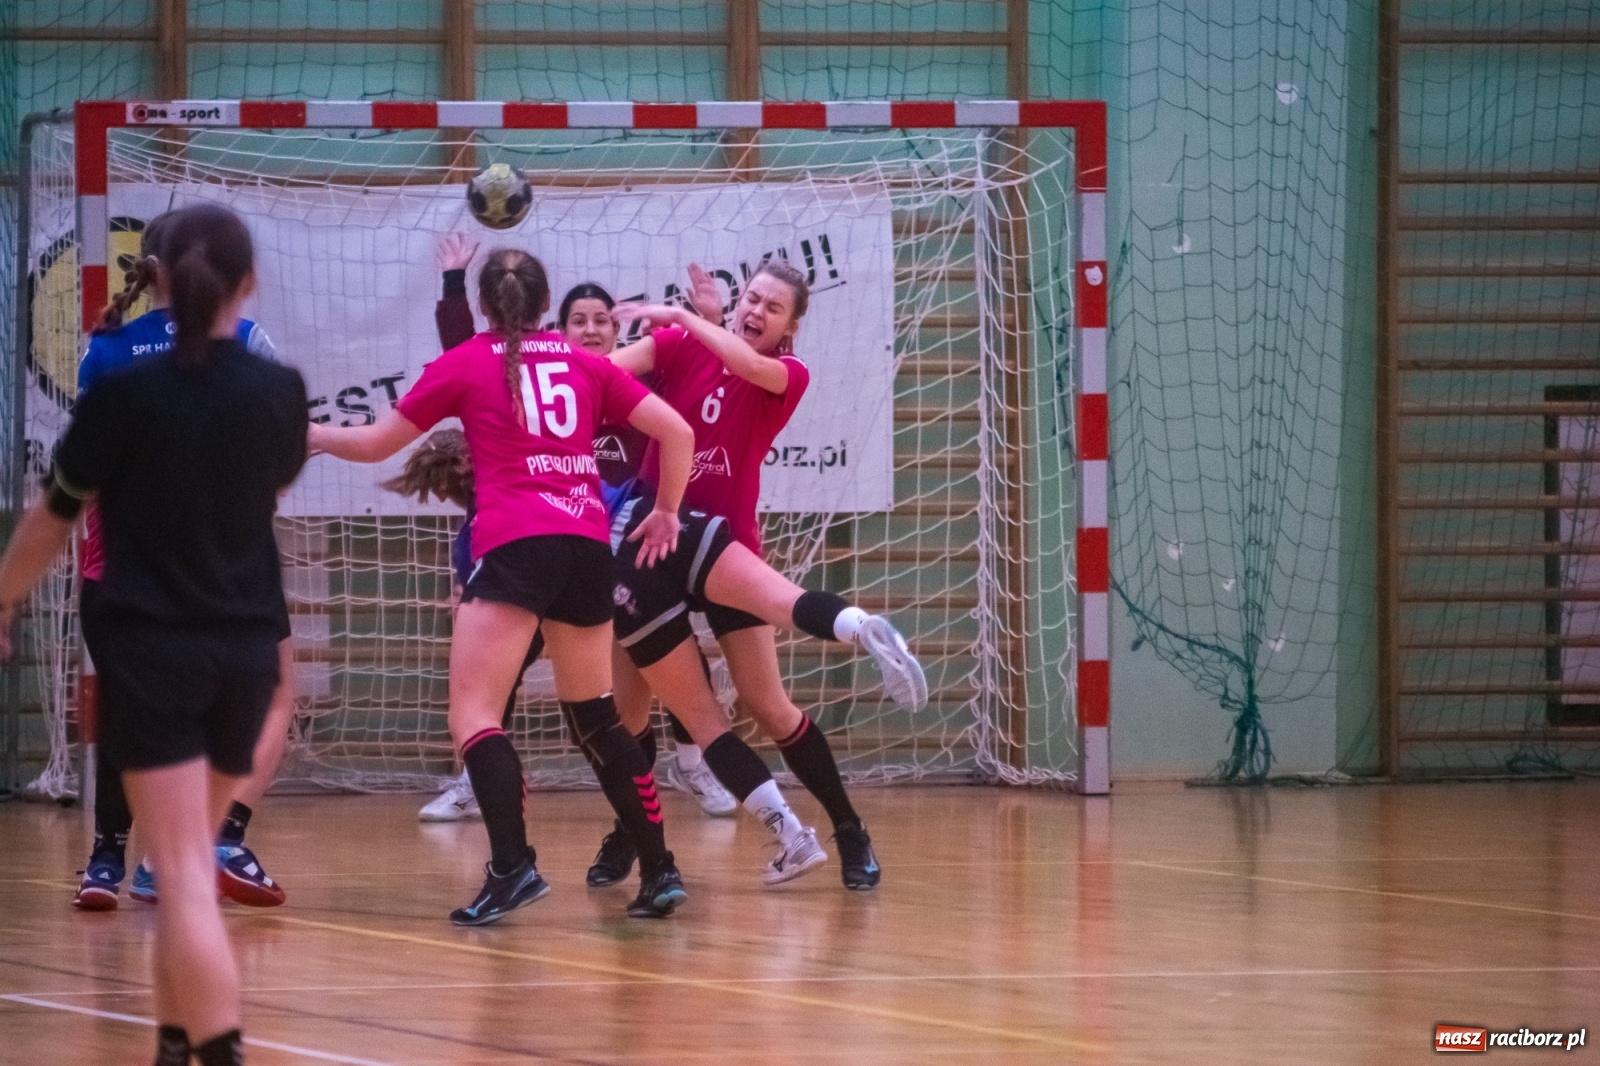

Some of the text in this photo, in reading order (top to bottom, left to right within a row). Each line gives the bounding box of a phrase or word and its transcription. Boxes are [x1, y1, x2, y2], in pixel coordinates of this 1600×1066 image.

[179, 107, 221, 122] sport
[132, 344, 151, 355] SPR
[491, 341, 572, 355] MNOWSKA
[519, 361, 578, 438] 15
[701, 386, 725, 424] 6
